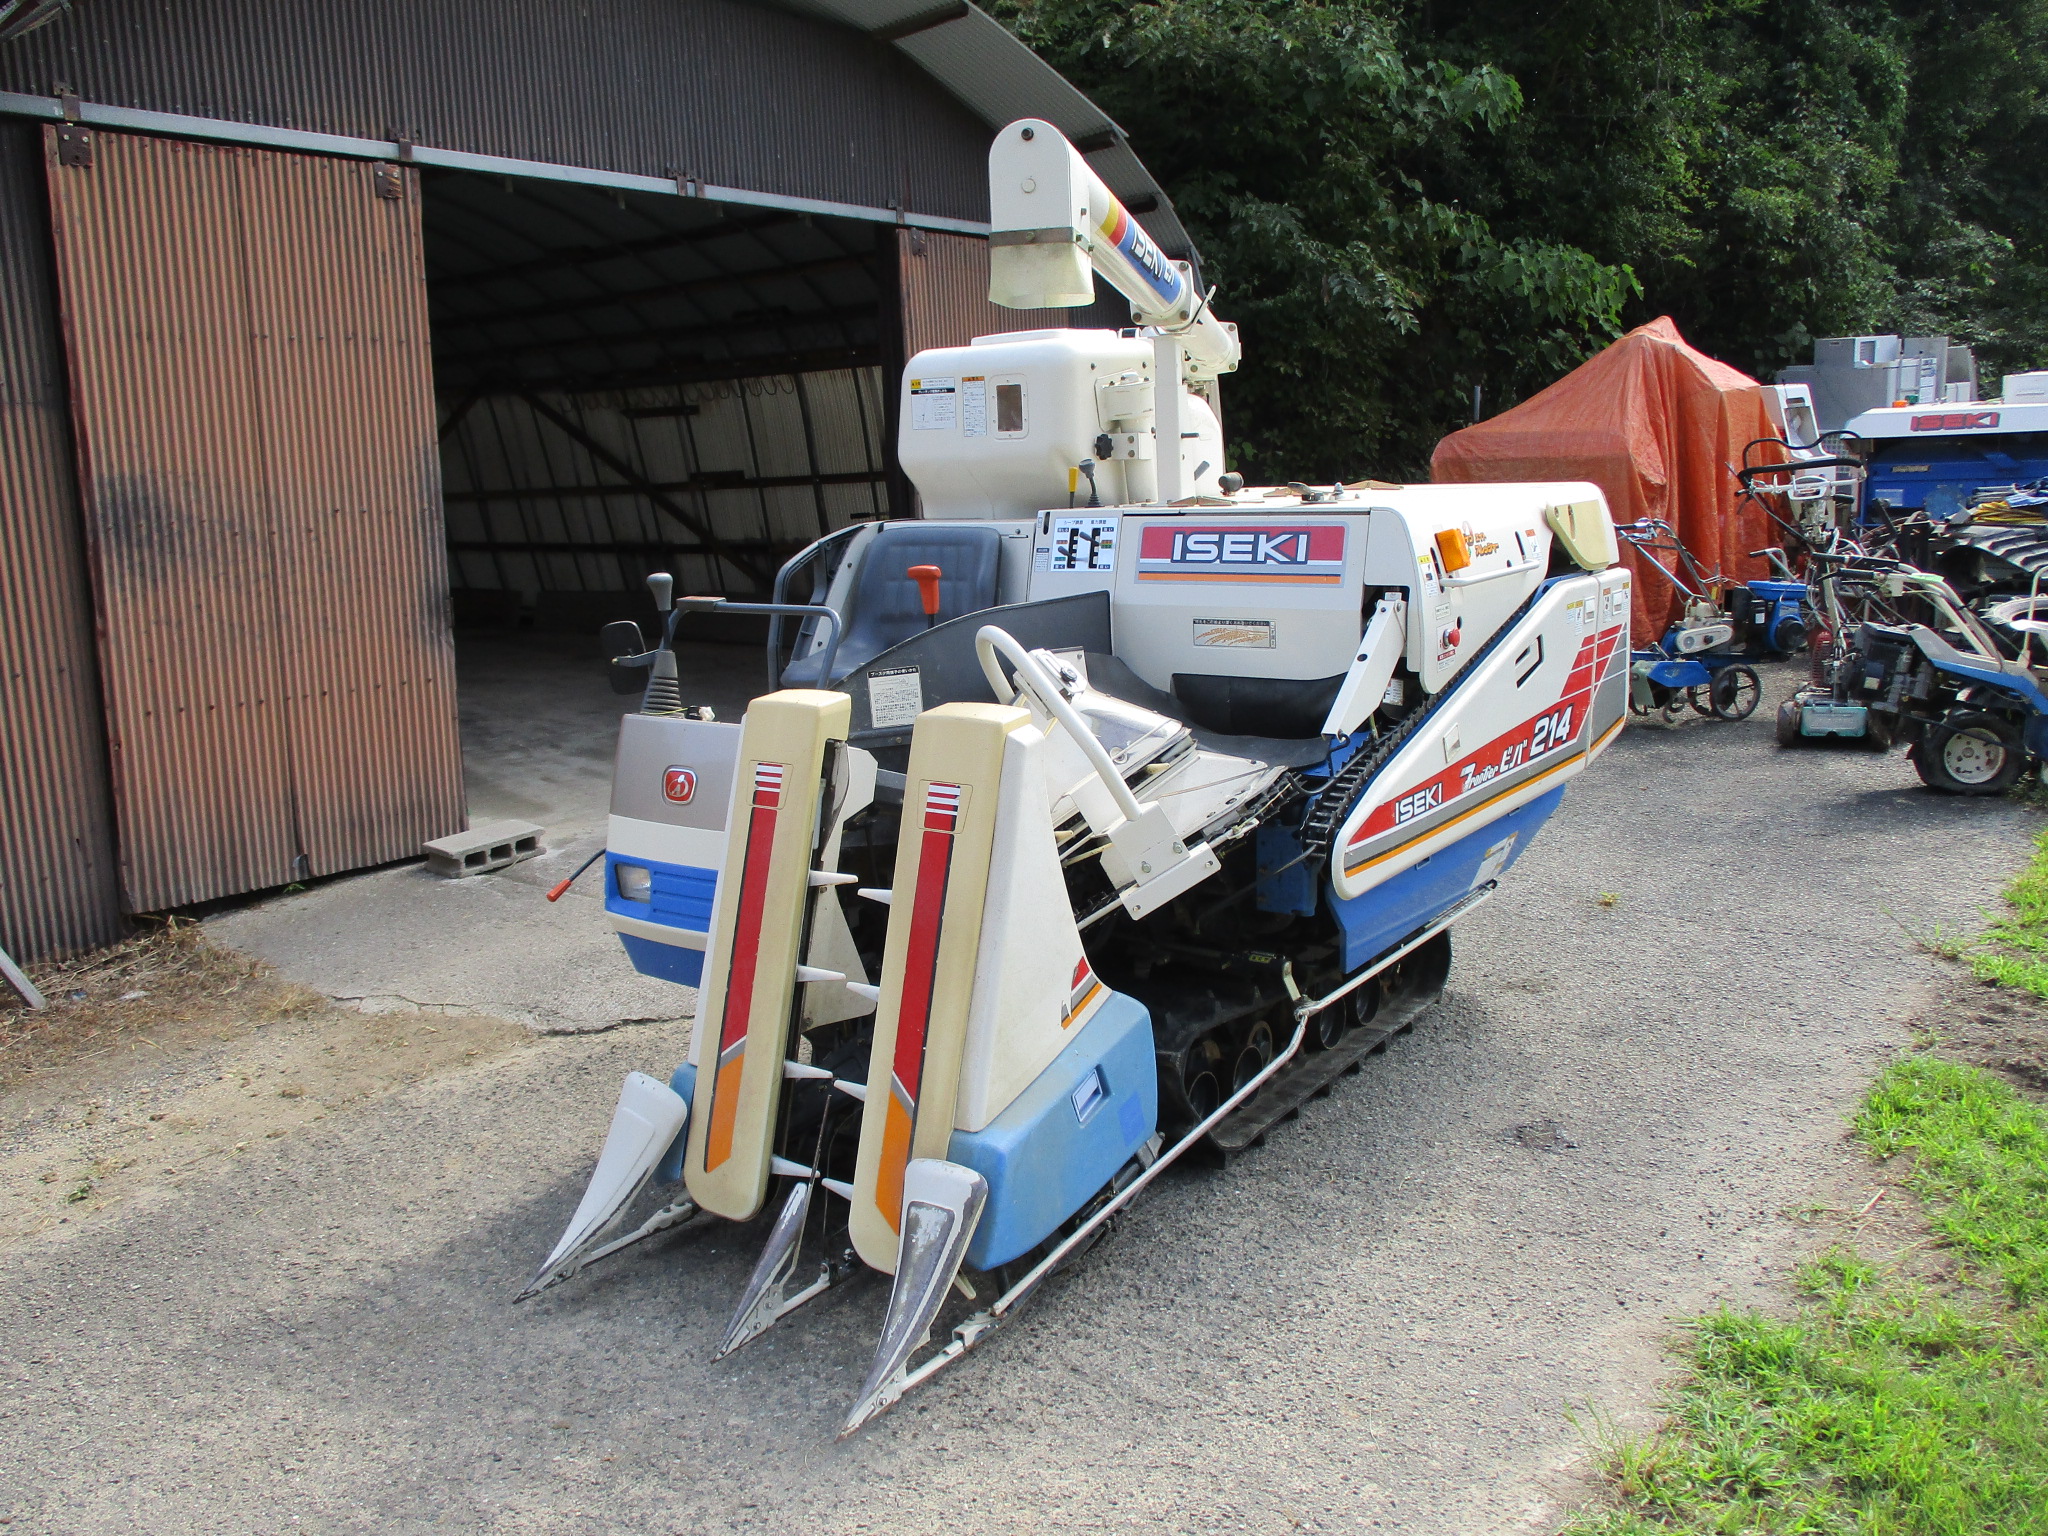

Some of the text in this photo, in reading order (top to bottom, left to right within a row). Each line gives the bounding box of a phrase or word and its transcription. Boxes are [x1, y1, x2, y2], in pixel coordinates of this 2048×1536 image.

[1910, 412, 2000, 431] ISEKI
[1171, 531, 1309, 565] ISEKI
[1394, 704, 1574, 824] ISEKI Frontier ビバ 214
